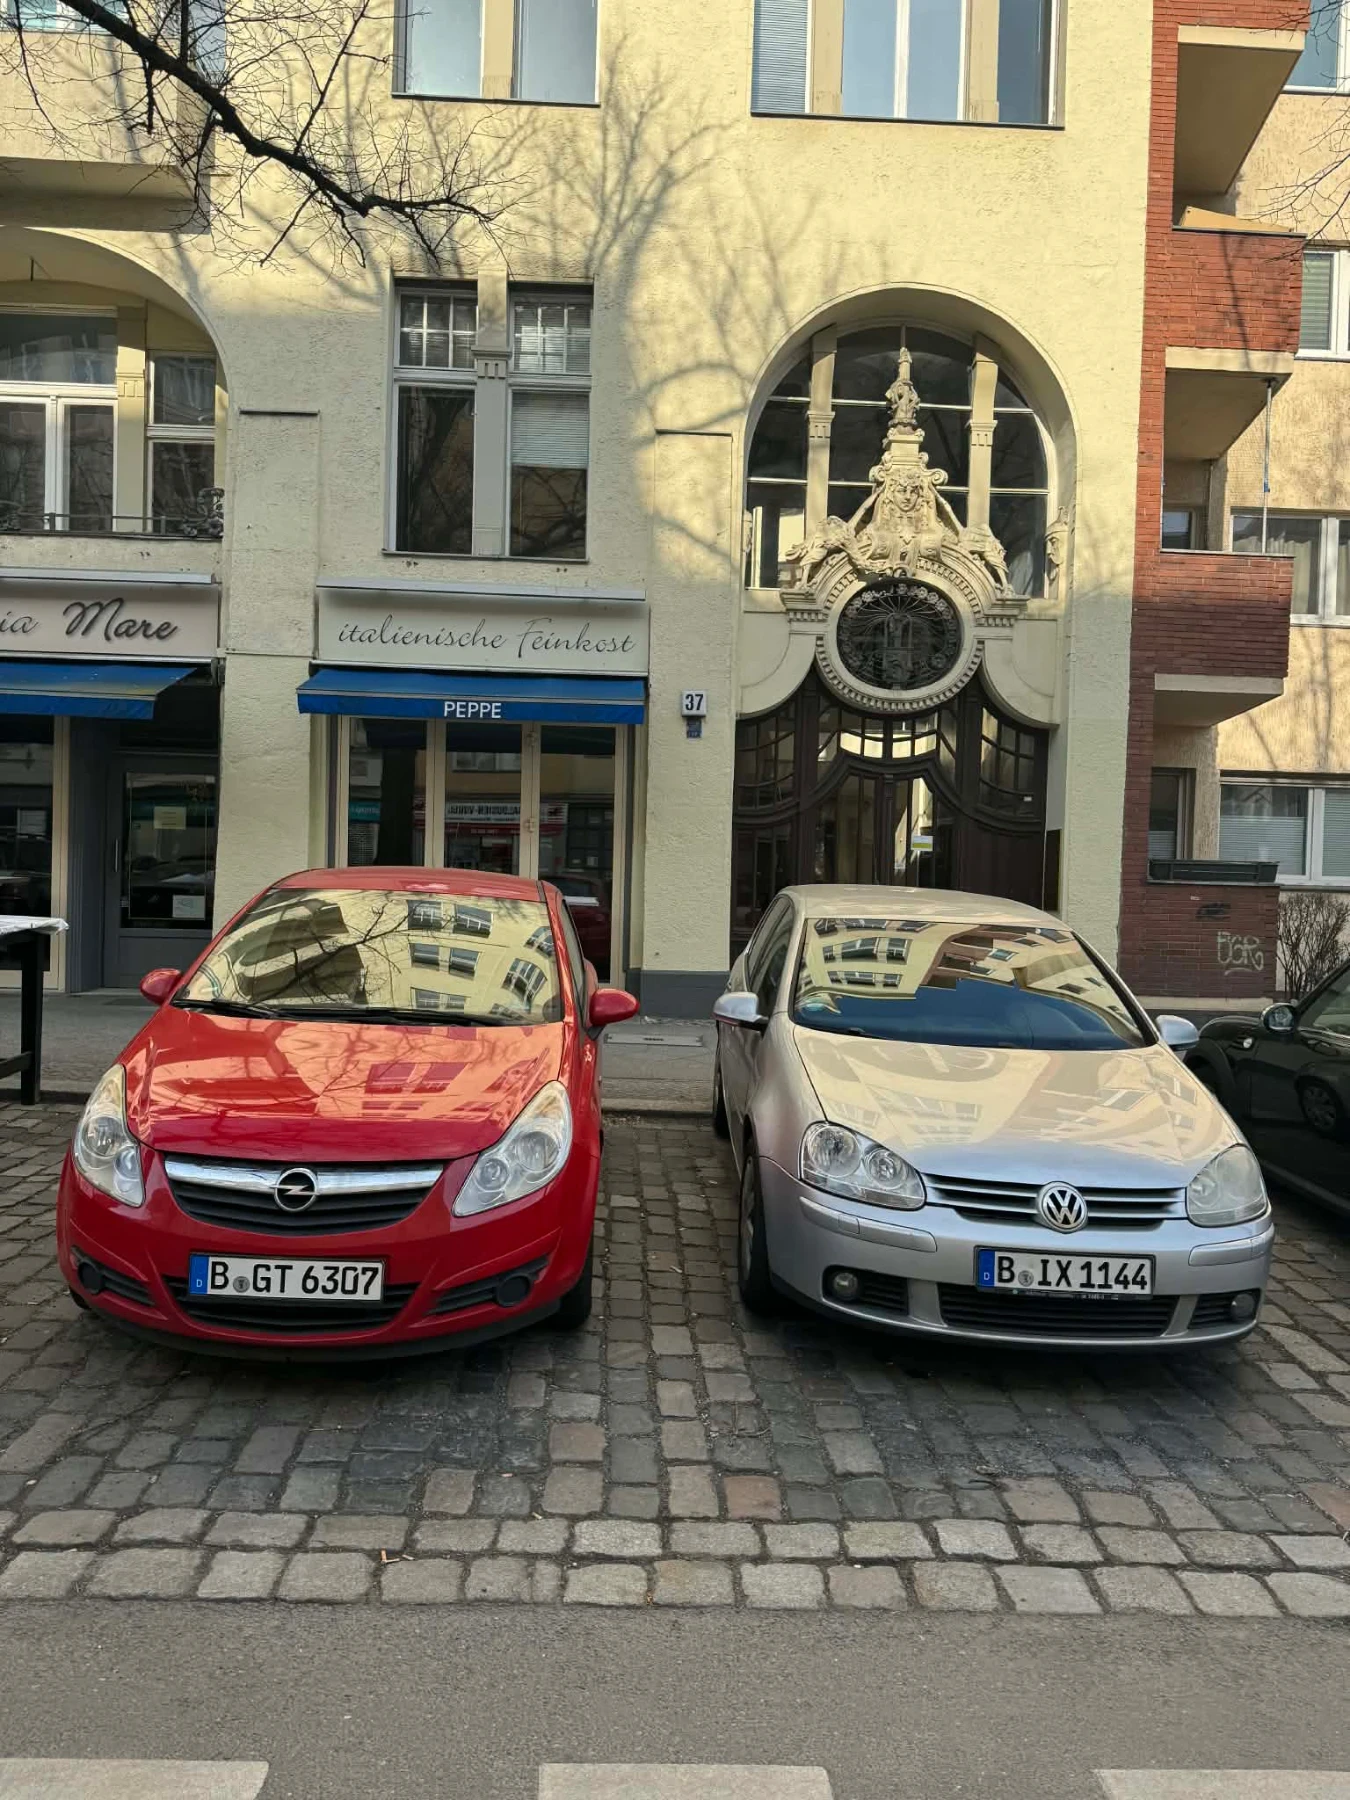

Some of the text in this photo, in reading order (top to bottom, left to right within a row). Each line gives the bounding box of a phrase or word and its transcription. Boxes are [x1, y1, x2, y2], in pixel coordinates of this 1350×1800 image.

[0, 597, 178, 641] ia Mare
[338, 613, 637, 658] italienische Feinkost
[444, 701, 502, 719] PEPPE
[685, 693, 703, 711] 37
[195, 1261, 379, 1296] D B GT 6307
[983, 1256, 1148, 1290] D B IX 1144
